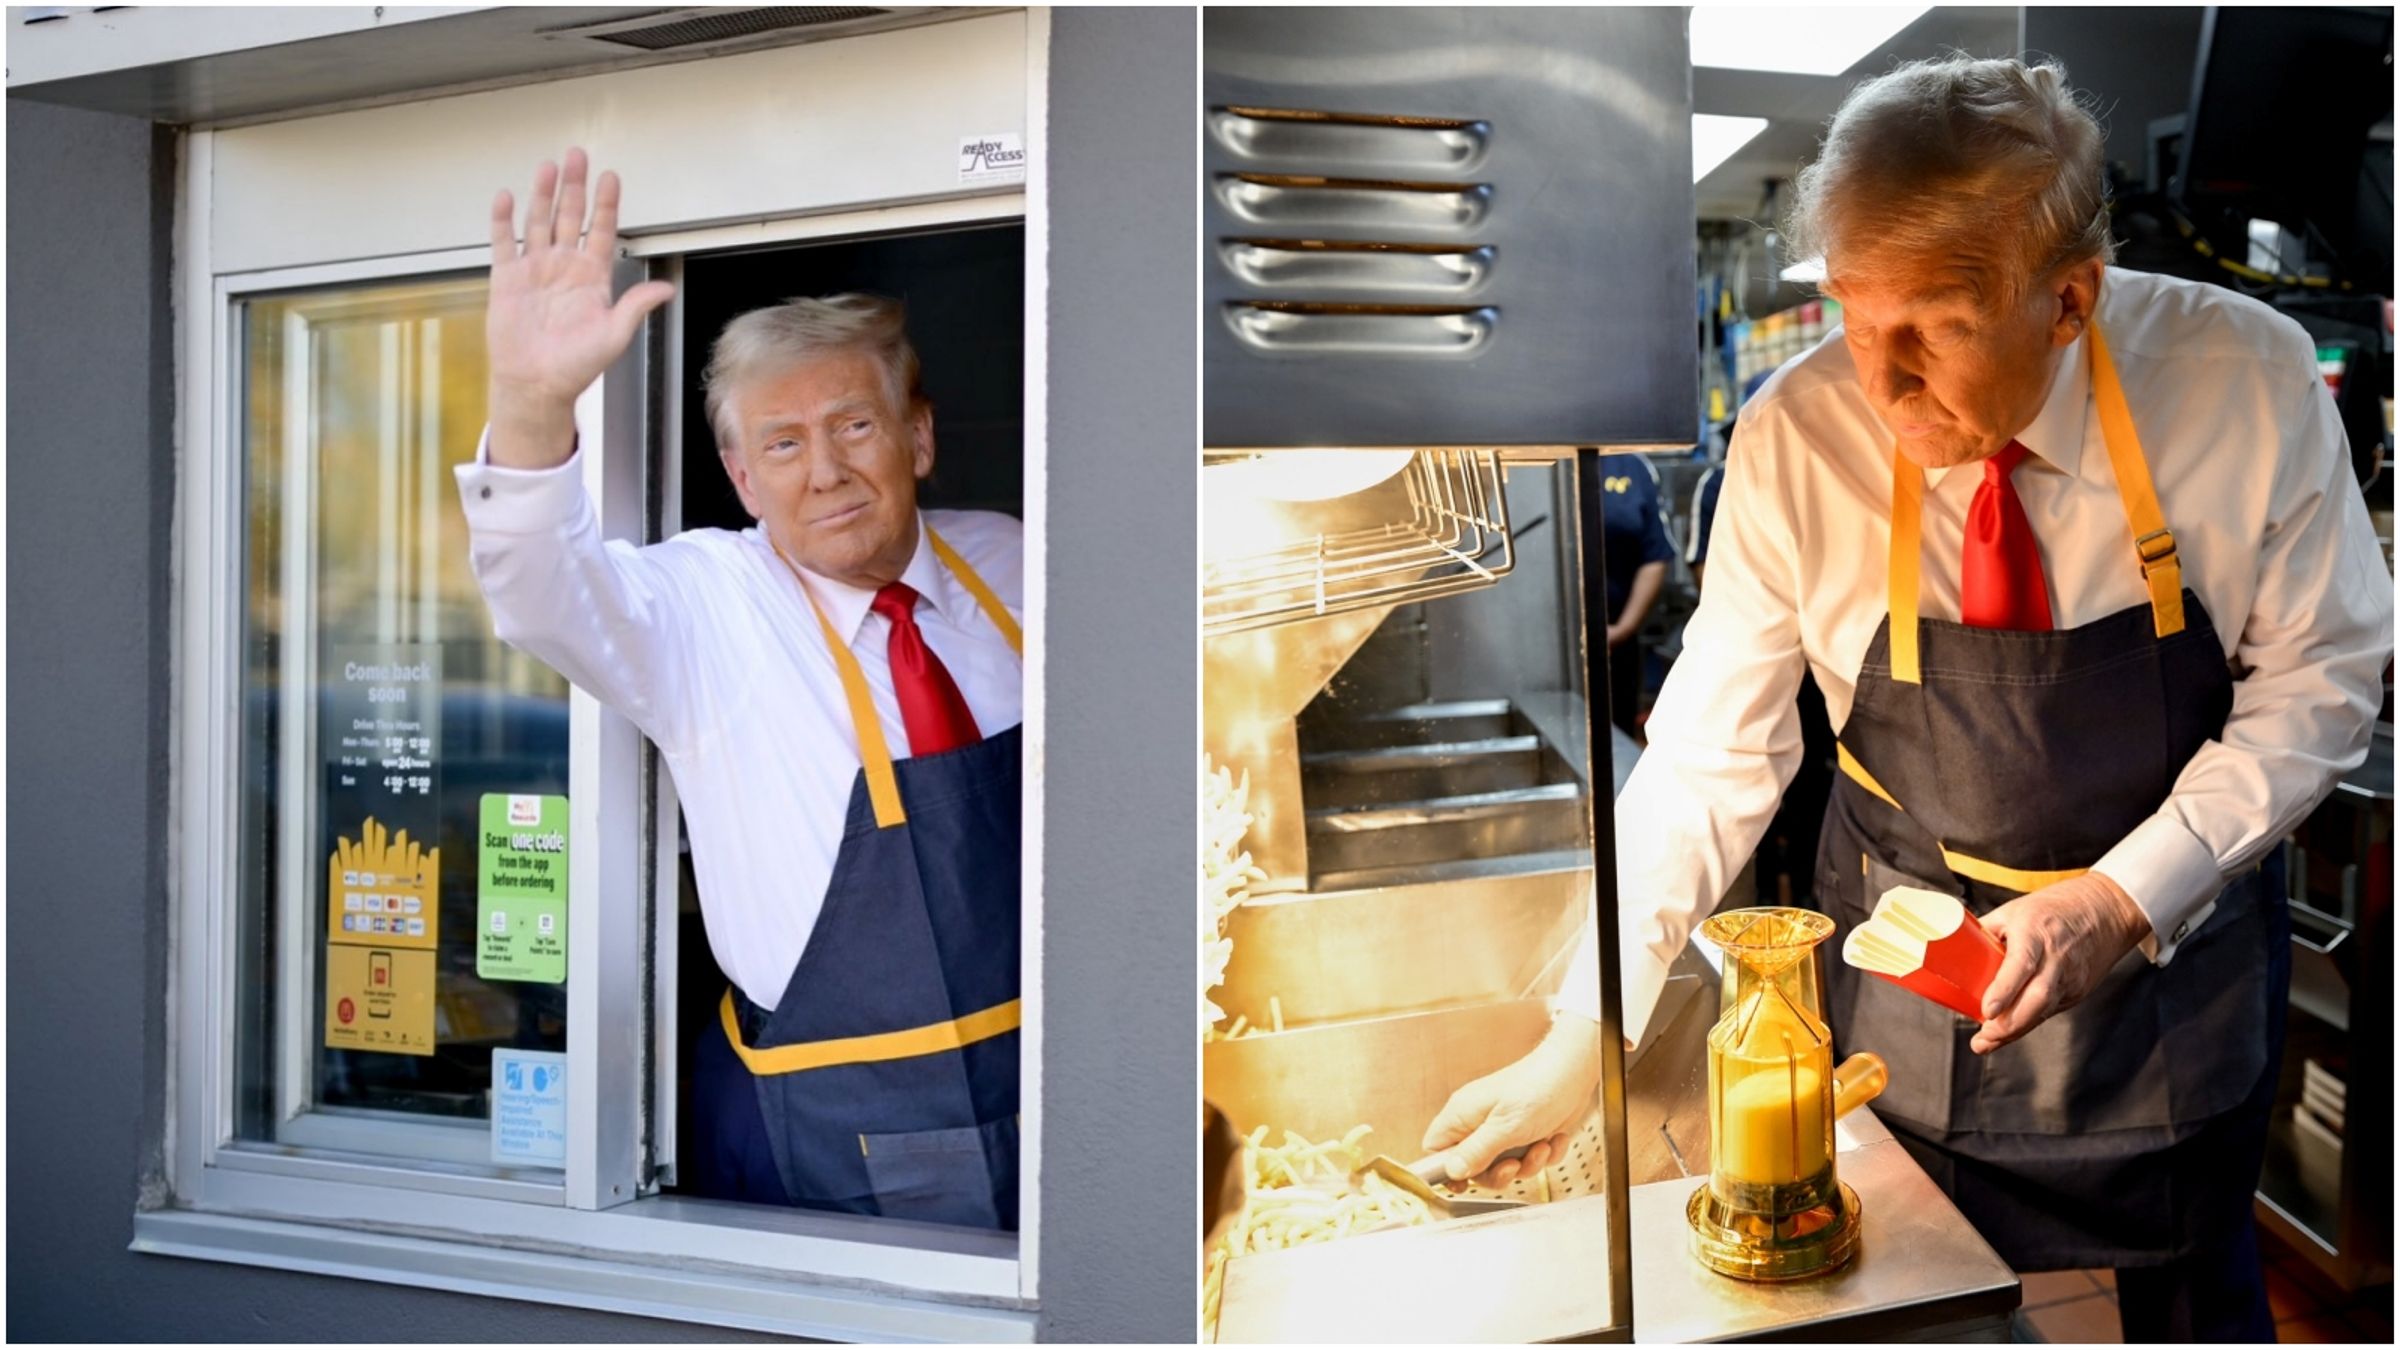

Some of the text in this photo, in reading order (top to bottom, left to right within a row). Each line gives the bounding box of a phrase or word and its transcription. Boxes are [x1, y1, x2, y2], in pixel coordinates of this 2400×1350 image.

[961, 140, 1003, 156] READY
[345, 661, 431, 681] Come back
[368, 687, 407, 703] soon
[353, 718, 374, 730] Drive
[398, 756, 411, 770] 24
[485, 829, 564, 853] Scan one code
[498, 854, 549, 874] from the app
[492, 873, 555, 892] before ordering
